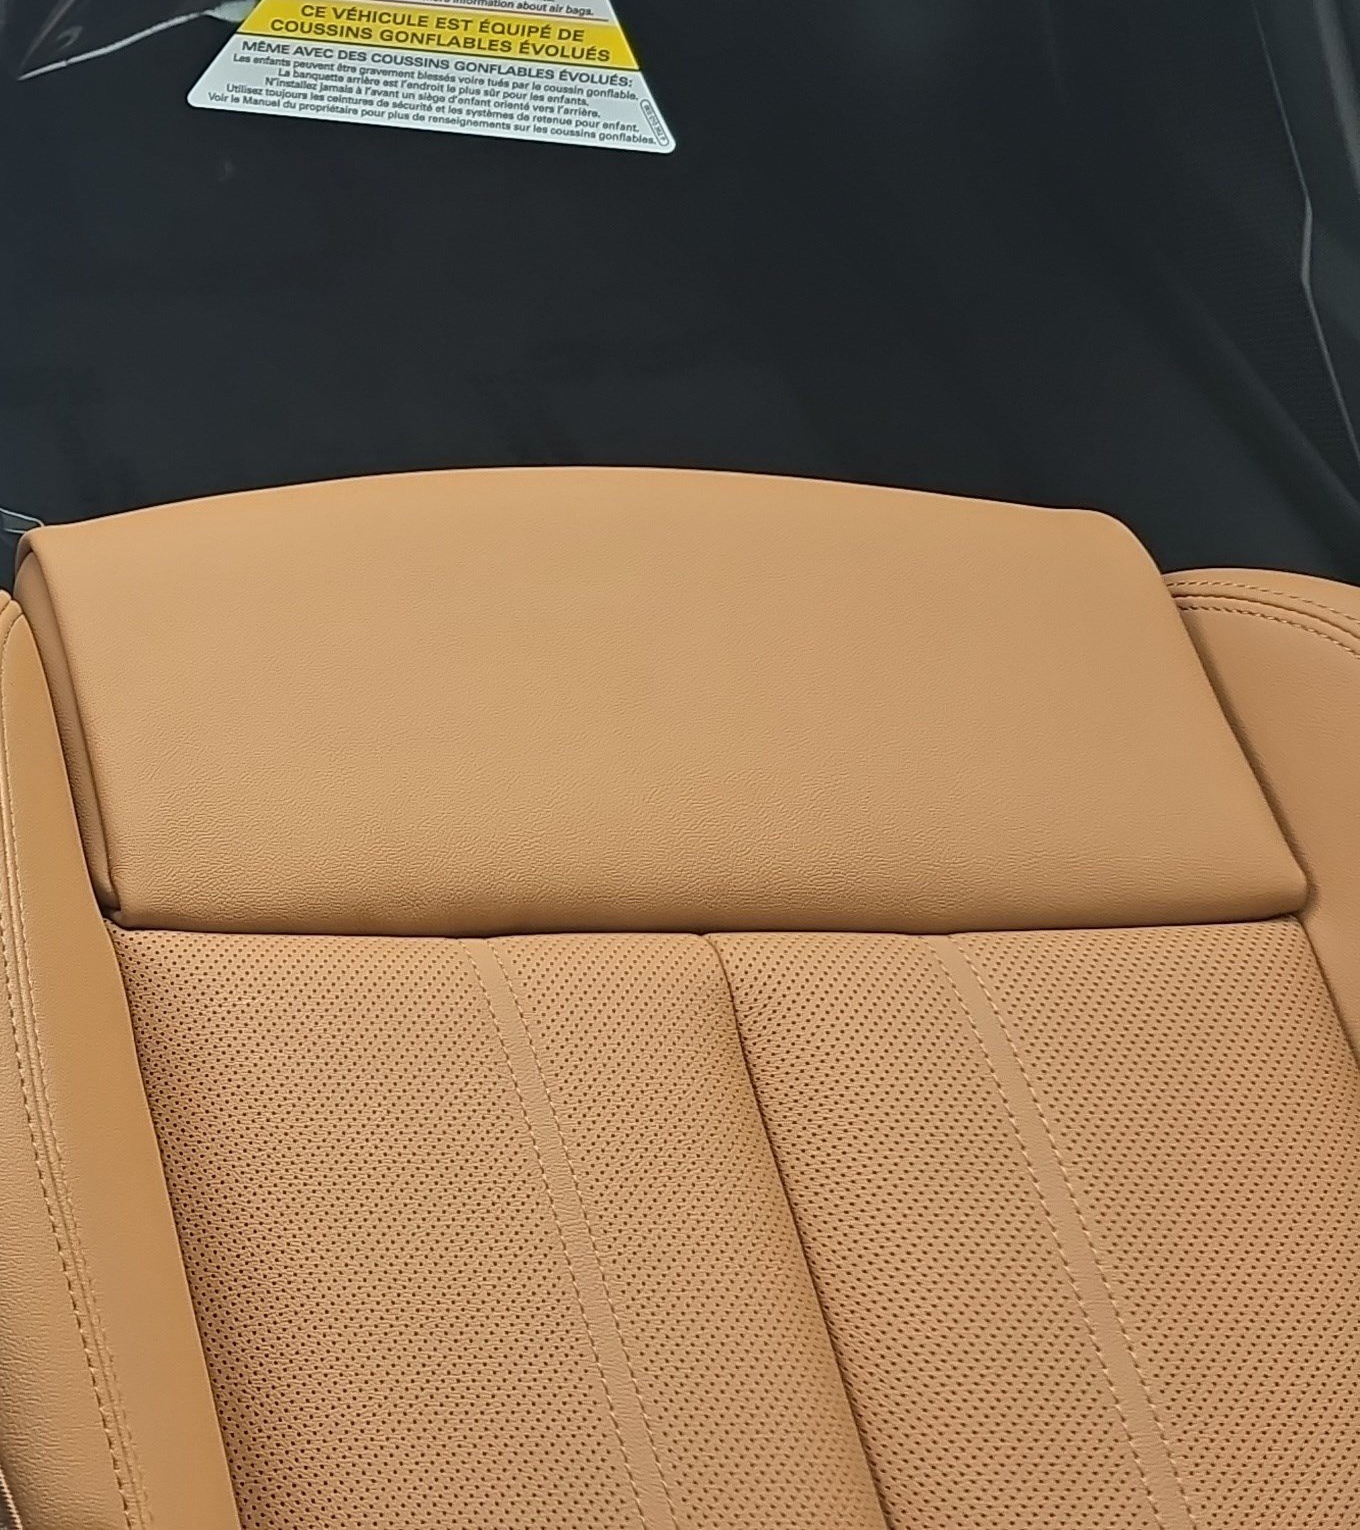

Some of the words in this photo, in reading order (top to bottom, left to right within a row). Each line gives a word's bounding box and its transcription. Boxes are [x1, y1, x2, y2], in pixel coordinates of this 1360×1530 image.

[269, 18, 372, 39] COUSSINS
[378, 28, 512, 53] GONFLABLES
[518, 39, 610, 62] ÉVOLUÉS
[300, 4, 327, 18] CE
[331, 5, 429, 27] VÉHICULE
[434, 16, 473, 31] EST
[478, 17, 551, 39] ÉQUIPÉ
[556, 27, 584, 42] DE
[241, 39, 290, 55] MÊME
[291, 45, 334, 59] AVEC
[336, 49, 367, 62] DES
[370, 52, 450, 70] COUSSINS
[453, 60, 554, 80] GONFLABLES
[558, 68, 632, 87] ÉVOLUÉS:
